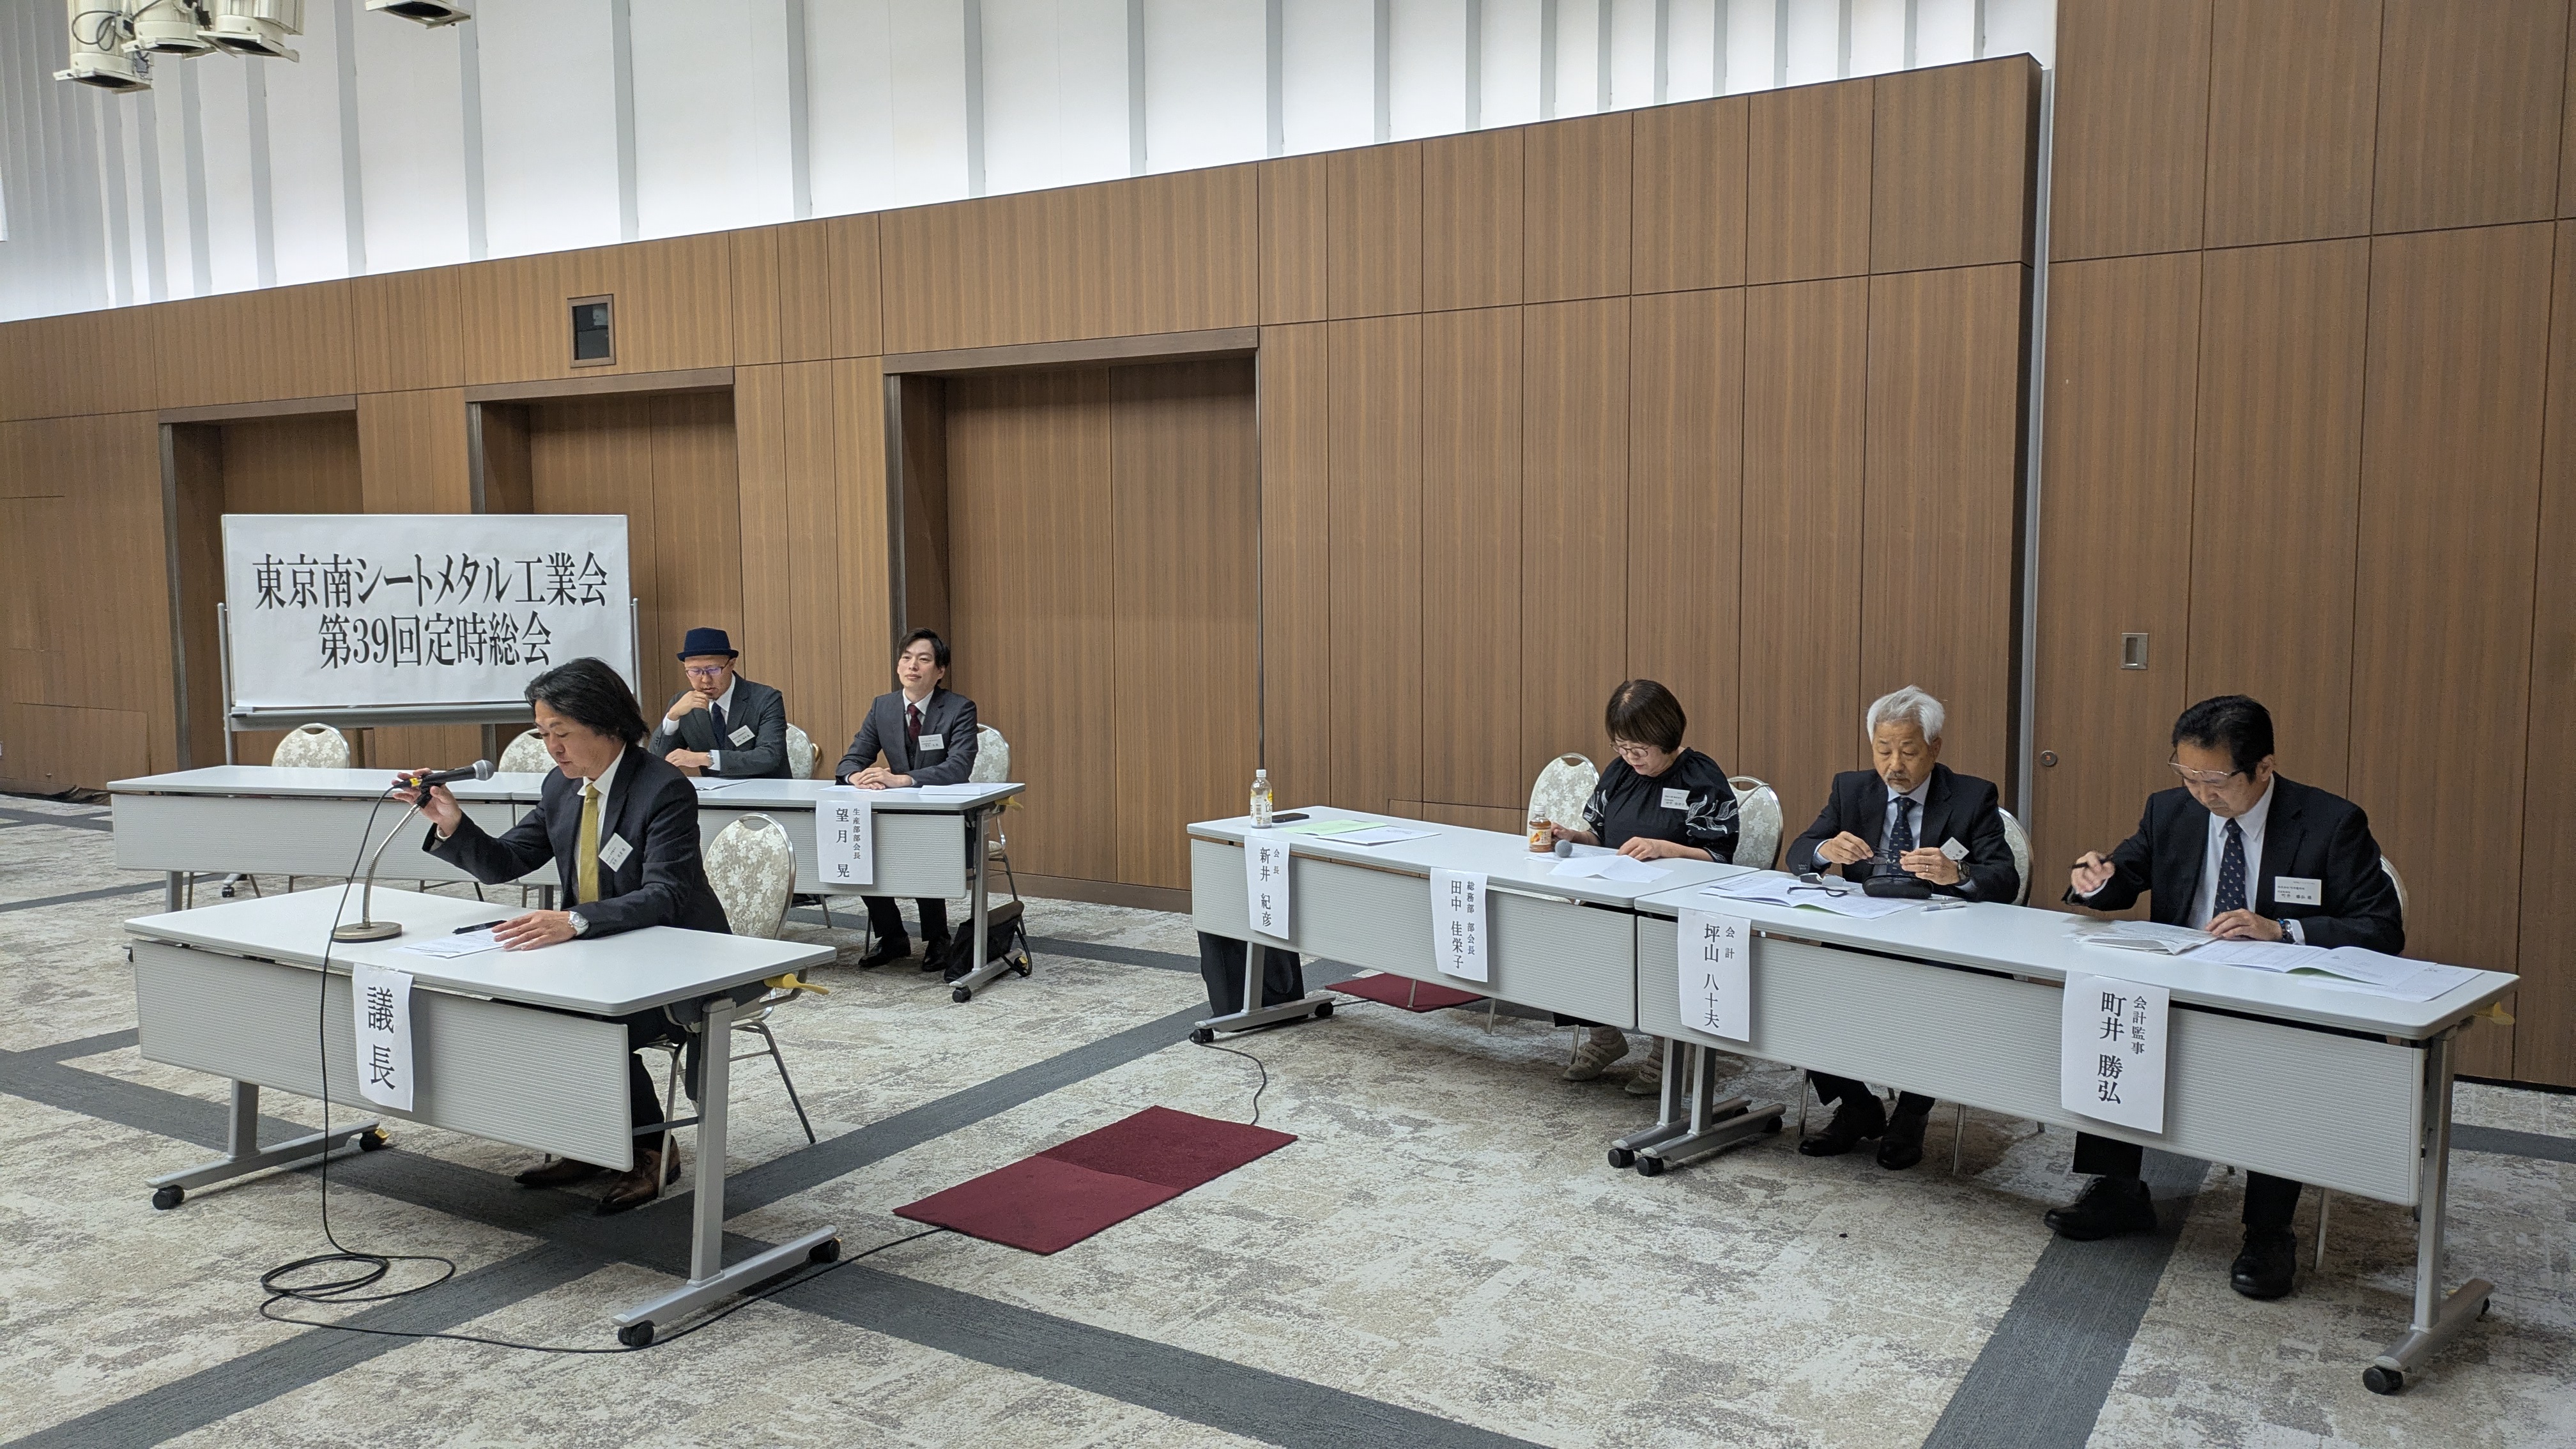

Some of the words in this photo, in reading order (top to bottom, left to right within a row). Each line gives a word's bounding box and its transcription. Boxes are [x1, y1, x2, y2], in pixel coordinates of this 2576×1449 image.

[252, 551, 608, 610] 東京南シートメタル工業会
[319, 611, 551, 669] 第39回定時総会
[836, 808, 849, 843] 望月
[852, 808, 861, 859] 生産部部会長
[836, 863, 850, 878] 晃
[1259, 847, 1271, 882] 新井
[1273, 848, 1280, 875] 会長
[1261, 893, 1272, 927] 紀彦
[1451, 880, 1462, 912] 田中
[1466, 880, 1475, 914] 総務部
[1451, 921, 1464, 969] 佳栄子
[1467, 922, 1475, 955] 部会長
[1704, 923, 1721, 963] 坪山
[1725, 926, 1735, 960] 会計
[1703, 973, 1720, 1029] 八十夫
[2099, 991, 2128, 1042] 町井
[367, 986, 396, 1090] 議長
[2131, 995, 2147, 1055] 会計監事
[2097, 1054, 2123, 1105] 勝弘
